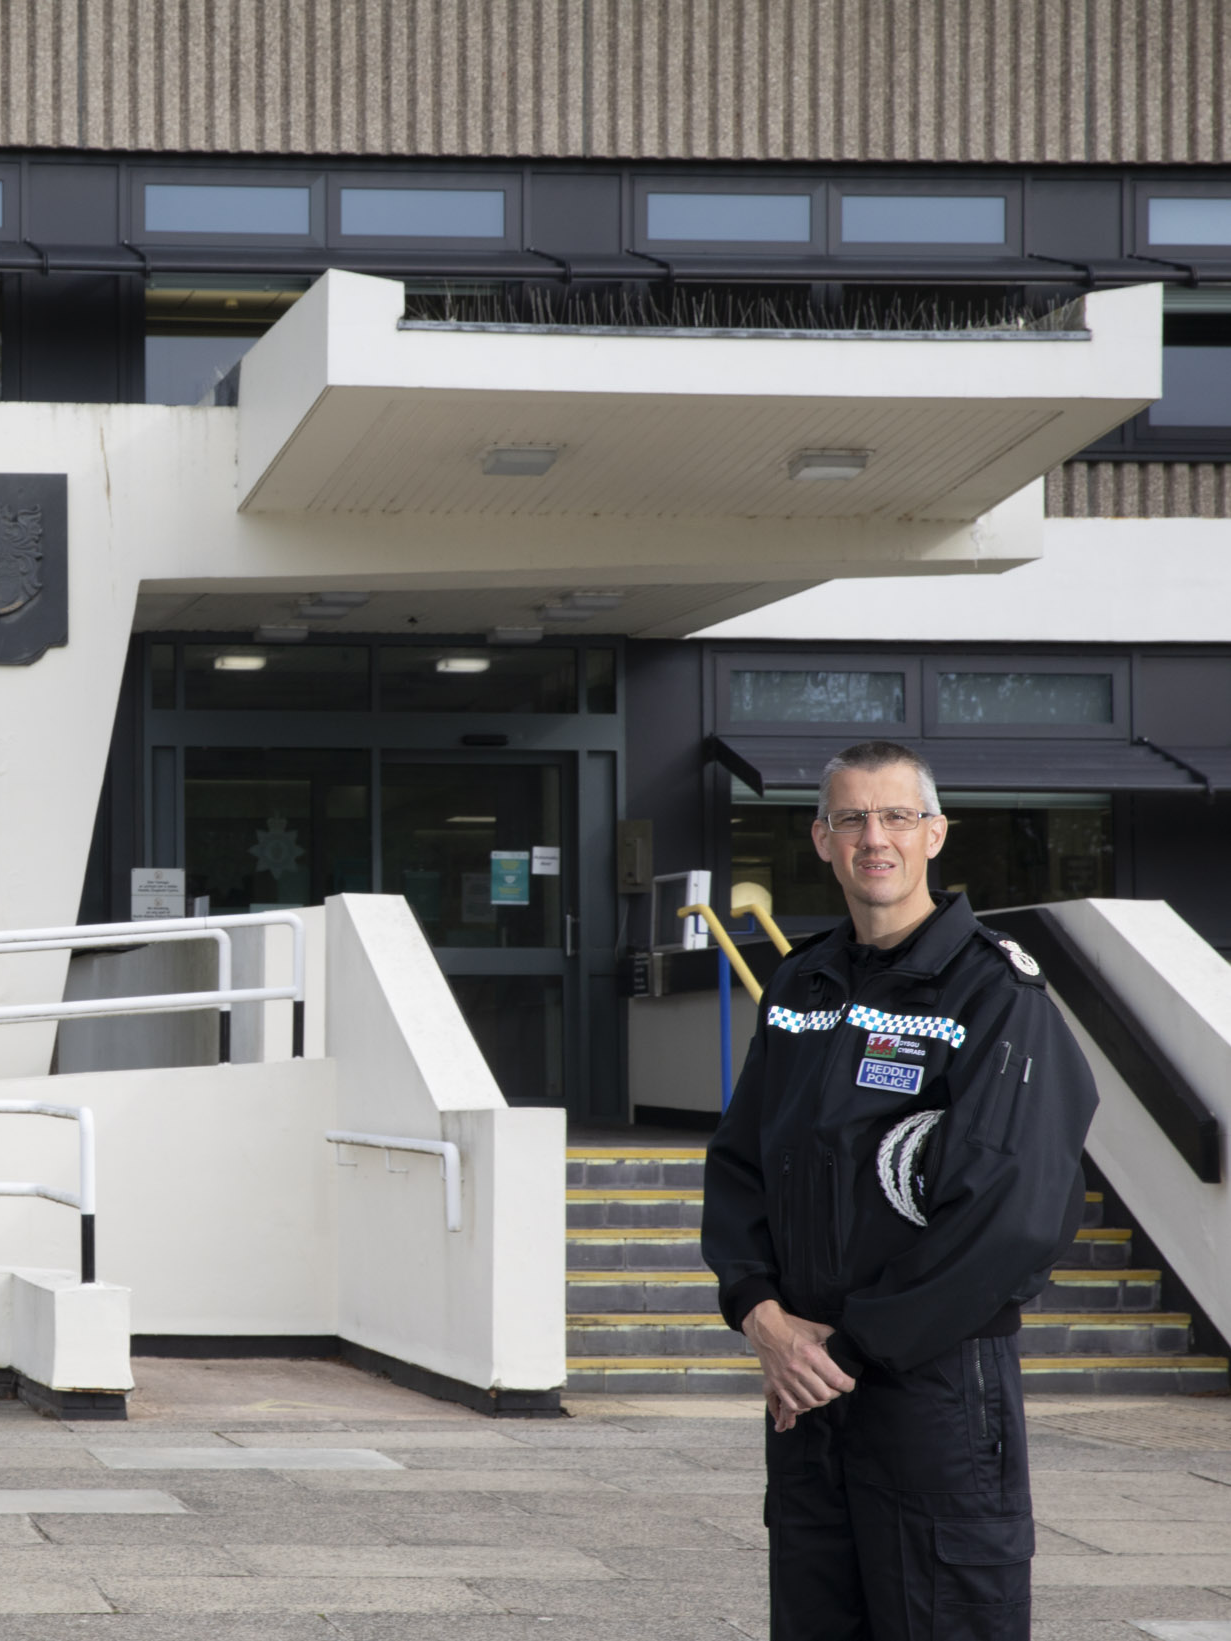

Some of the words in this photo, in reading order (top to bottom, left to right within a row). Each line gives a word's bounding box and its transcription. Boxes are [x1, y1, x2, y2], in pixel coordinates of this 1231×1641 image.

[897, 1047, 926, 1056] CYMRAEG
[866, 1063, 916, 1079] HEDDLU
[866, 1073, 911, 1089] POLICE
